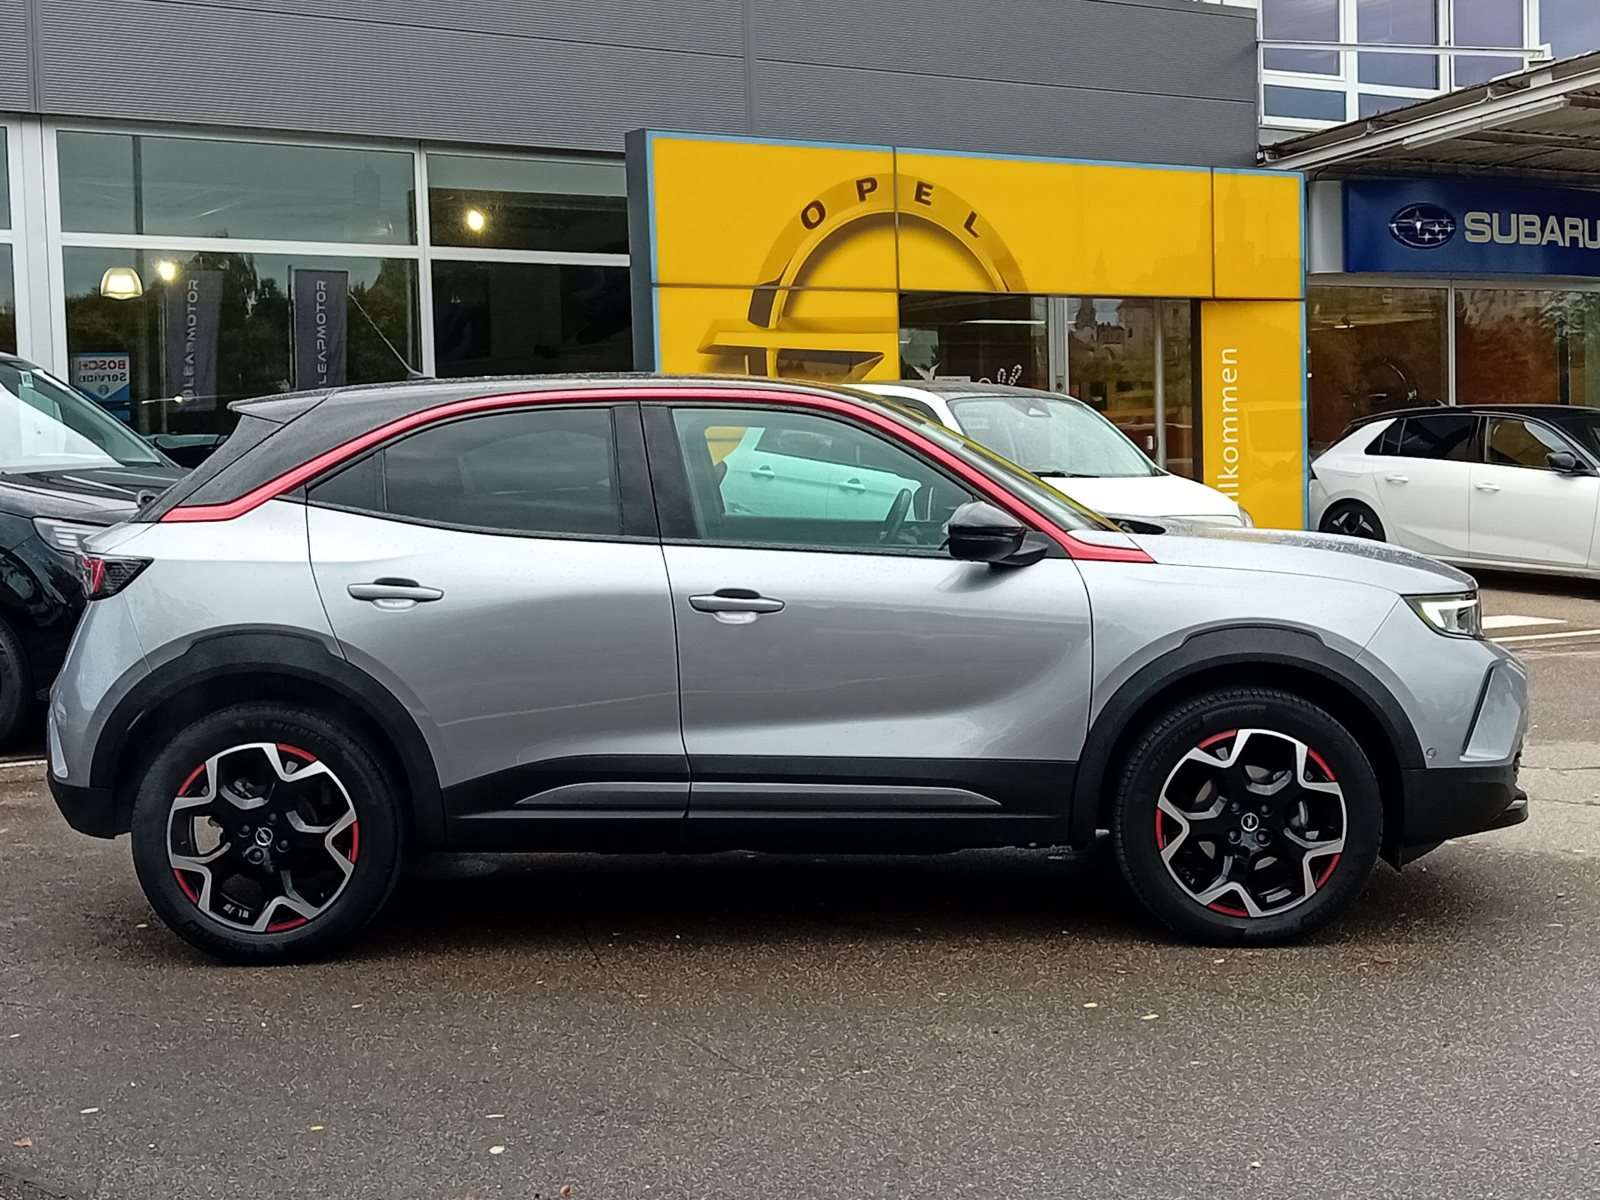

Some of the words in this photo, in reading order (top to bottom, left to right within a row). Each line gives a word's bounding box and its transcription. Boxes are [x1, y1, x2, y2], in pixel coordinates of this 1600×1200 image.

[801, 177, 980, 238] OPEL
[1464, 211, 1600, 249] SUBARU
[183, 279, 199, 387] LEAPMOTOR
[316, 279, 327, 385] LEAPMOTOR
[1217, 348, 1239, 504] llkommen
